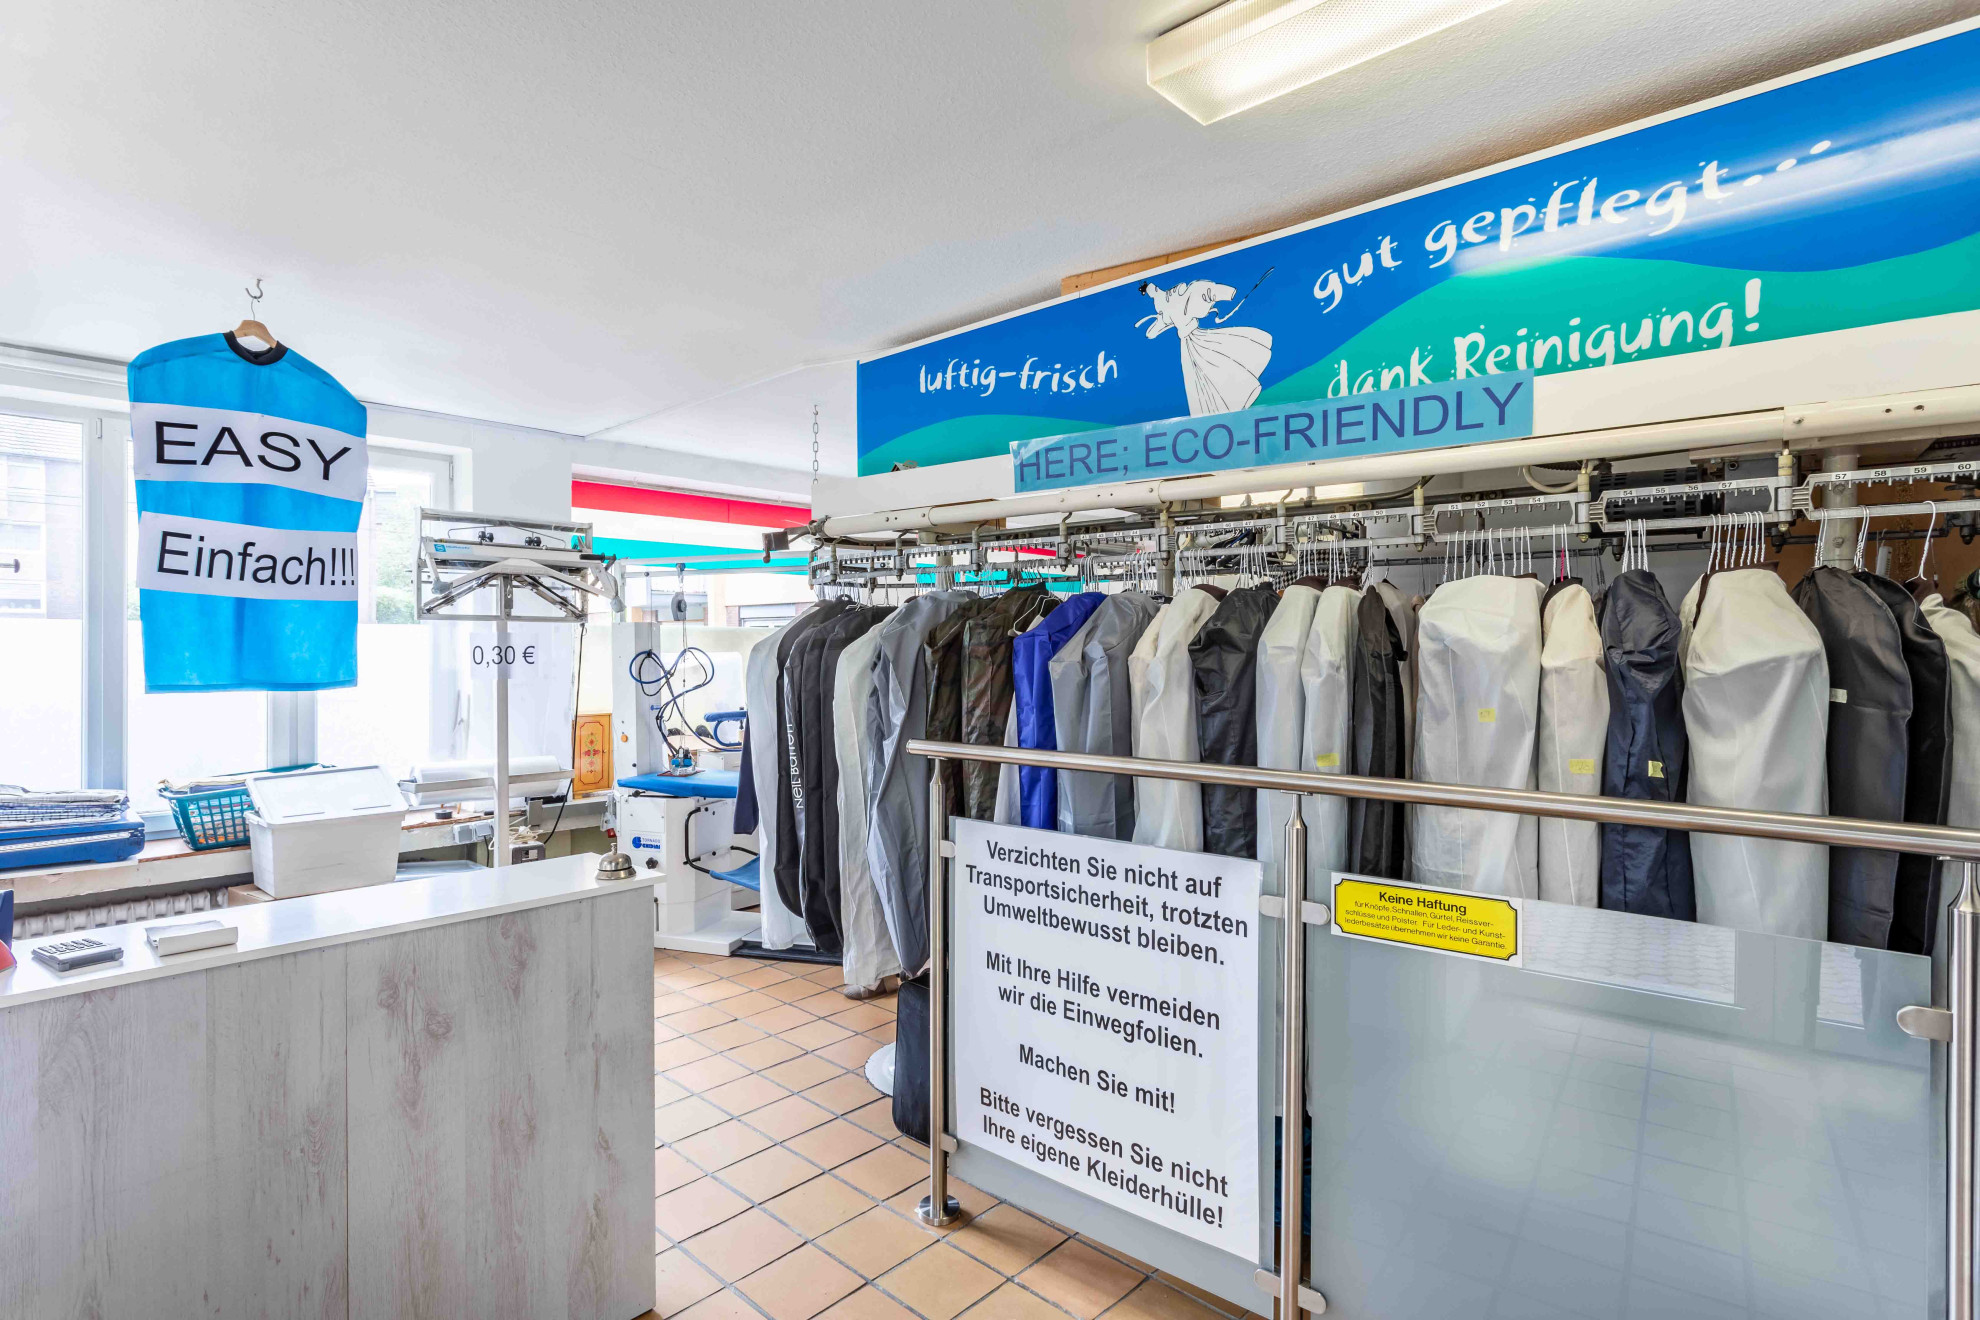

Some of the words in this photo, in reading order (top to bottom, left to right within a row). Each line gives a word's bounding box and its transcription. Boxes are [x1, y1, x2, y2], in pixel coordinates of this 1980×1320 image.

[1313, 235, 1402, 314] gut
[1425, 140, 1832, 269] gepflegt...
[919, 350, 1118, 397] luftig-frisch
[1327, 345, 1434, 399] dank
[1451, 277, 1762, 380] Reinigung!
[155, 420, 352, 481] EASY
[1018, 437, 1129, 484] HERE;
[1144, 381, 1524, 468] ECO-FRIENDLY
[157, 530, 355, 586] Einfach!!!
[472, 645, 516, 668] 0,30
[522, 645, 536, 665] €
[966, 864, 1154, 923] Transportsicherheit,
[1161, 900, 1248, 938] trotzten
[986, 839, 1080, 874] Verzichten
[1087, 856, 1117, 881] Sie
[1124, 864, 1178, 892] nicht
[1185, 876, 1222, 898] auf
[1379, 891, 1413, 906] Keine
[1417, 896, 1467, 916] Haftung
[984, 894, 1131, 945] Umweltbewusst
[1137, 926, 1224, 965] bleiben.
[1344, 917, 1390, 931] lederbesätze
[1390, 925, 1436, 938] übernehmen
[1436, 932, 1448, 940] wir
[1449, 933, 1470, 944] keine
[1345, 909, 1376, 919] schlüsse
[1377, 914, 1390, 922] und
[1422, 920, 1434, 928] Für
[1436, 922, 1460, 932] Leder-
[1463, 927, 1478, 935] und
[1479, 929, 1506, 939] Kunst-
[1354, 900, 1364, 908] für
[1429, 911, 1455, 923] Gürtel,
[1456, 916, 1494, 928] Reissver-
[986, 950, 1012, 975] Mit
[1018, 958, 1051, 985] Ihre
[1057, 968, 1101, 998] Hilfe
[1107, 985, 1220, 1030] vermeiden
[998, 985, 1025, 1006] wir
[1030, 992, 1057, 1015] die
[1063, 999, 1202, 1058] Einwegfolien.
[1019, 1043, 1090, 1086] Machen
[1097, 1069, 1128, 1098] Sie
[1135, 1086, 1175, 1114] mit!
[980, 1086, 1020, 1117] Bitte
[1025, 1106, 1123, 1158] vergessen
[1130, 1142, 1163, 1173] Sie
[1171, 1161, 1228, 1198] nicht
[983, 1114, 1015, 1144] Ihre
[1021, 1133, 1080, 1171] eigene
[1087, 1156, 1223, 1229] Kleiderhülle!
